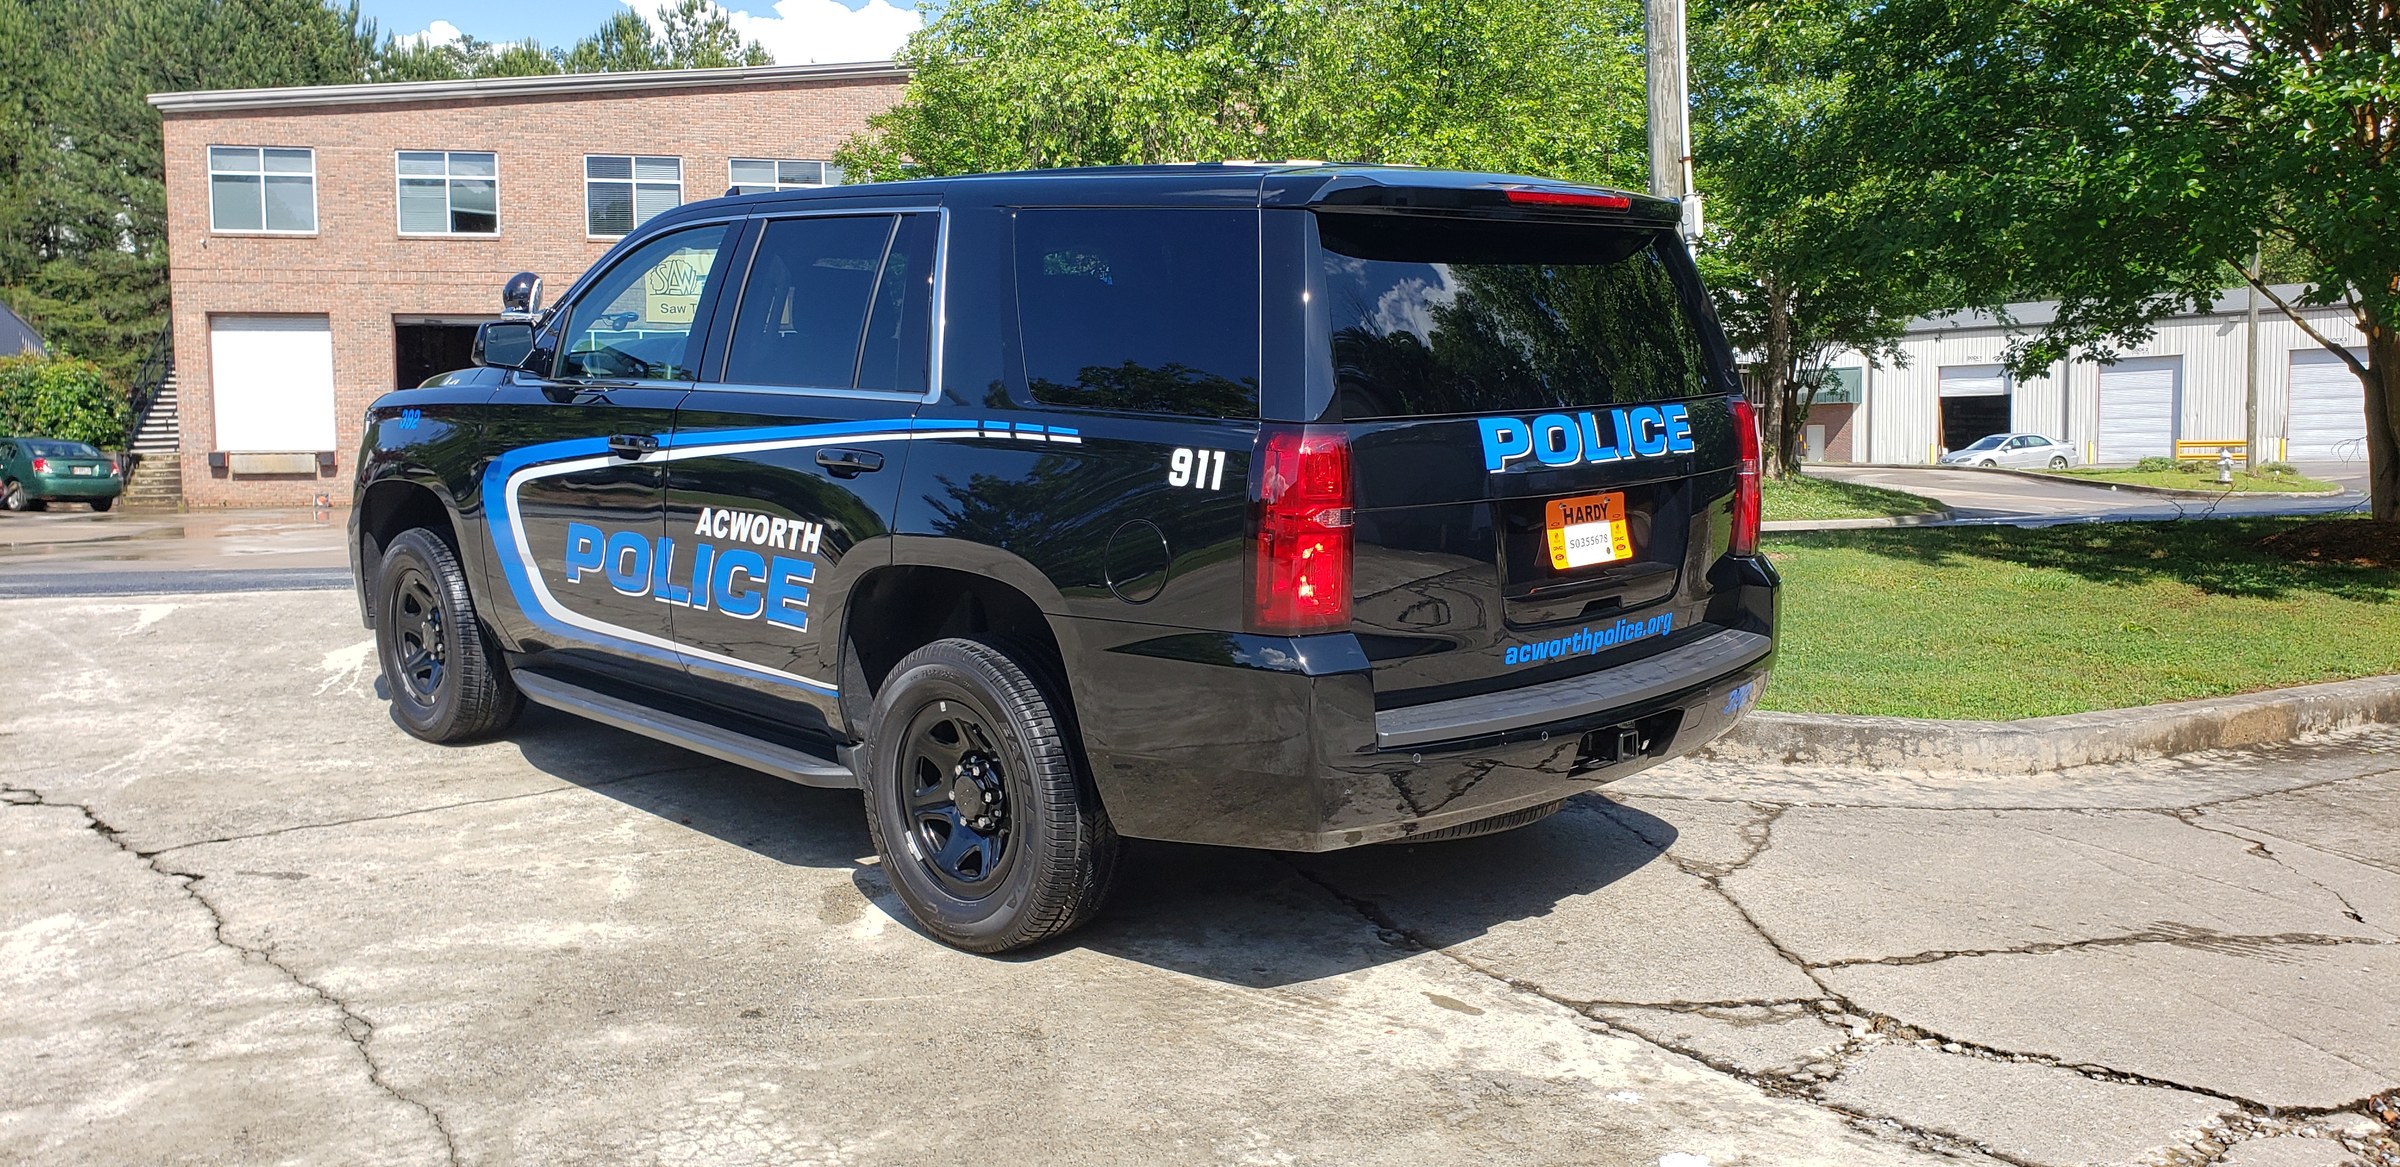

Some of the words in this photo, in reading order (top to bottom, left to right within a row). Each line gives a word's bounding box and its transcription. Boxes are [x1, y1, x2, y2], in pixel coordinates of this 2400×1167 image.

[654, 259, 697, 295] SAW
[660, 303, 687, 314] Saw
[1477, 403, 1696, 474] POLICE
[1168, 448, 1226, 490] 911
[694, 507, 823, 555] ACWORTH
[1563, 502, 1609, 526] HARDY
[565, 521, 816, 633] POLICE
[1504, 612, 1673, 665] acworthpolice.org
